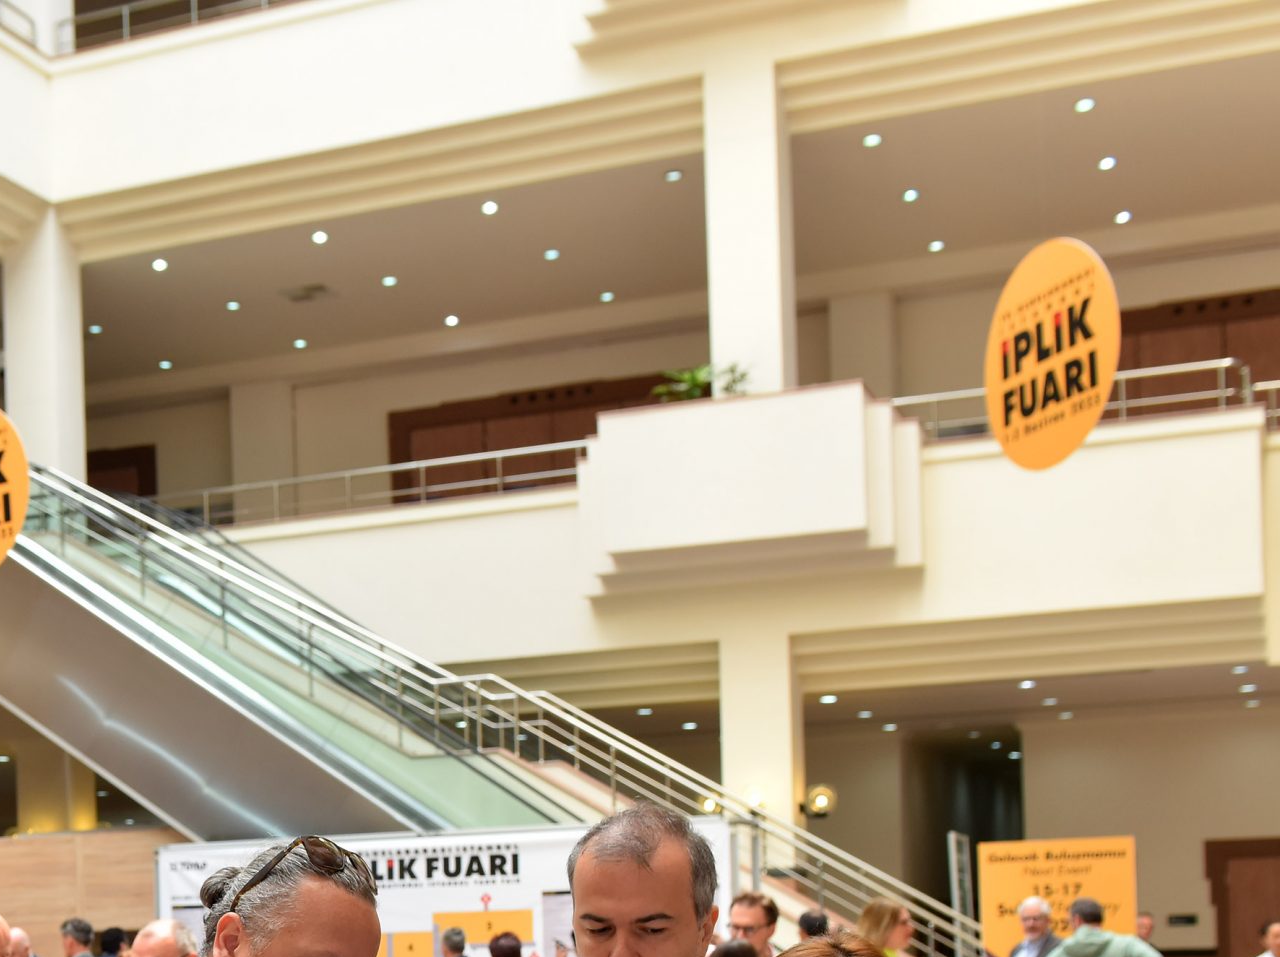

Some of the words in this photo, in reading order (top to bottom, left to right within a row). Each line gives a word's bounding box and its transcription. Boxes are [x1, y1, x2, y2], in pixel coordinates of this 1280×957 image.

[1003, 350, 1098, 427] FUARI
[372, 857, 417, 880] LİK
[426, 853, 520, 879] FUARI
